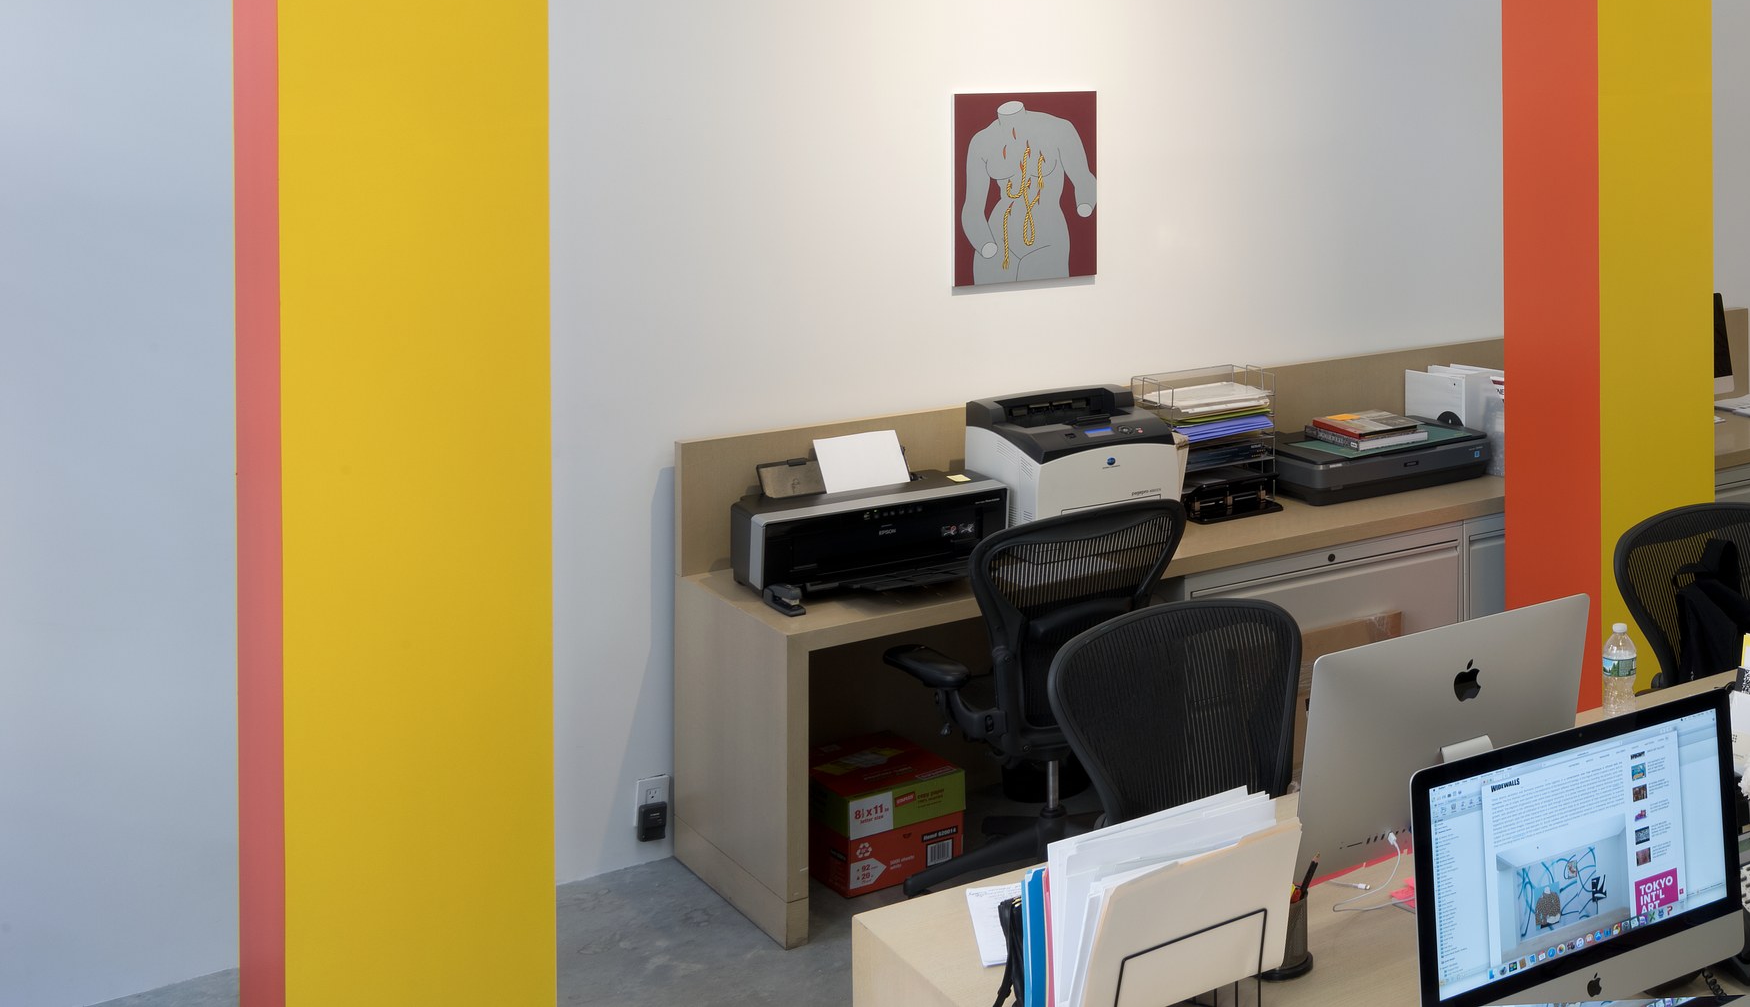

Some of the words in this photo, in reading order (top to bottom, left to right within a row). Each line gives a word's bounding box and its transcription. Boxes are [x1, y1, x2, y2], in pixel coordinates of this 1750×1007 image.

[879, 528, 896, 536] EPSON
[1490, 778, 1520, 793] WIDEWALLS
[873, 804, 884, 814] 11
[1639, 876, 1673, 895] TOKYO
[1640, 889, 1665, 905] INT'L
[1641, 900, 1660, 913] ART
